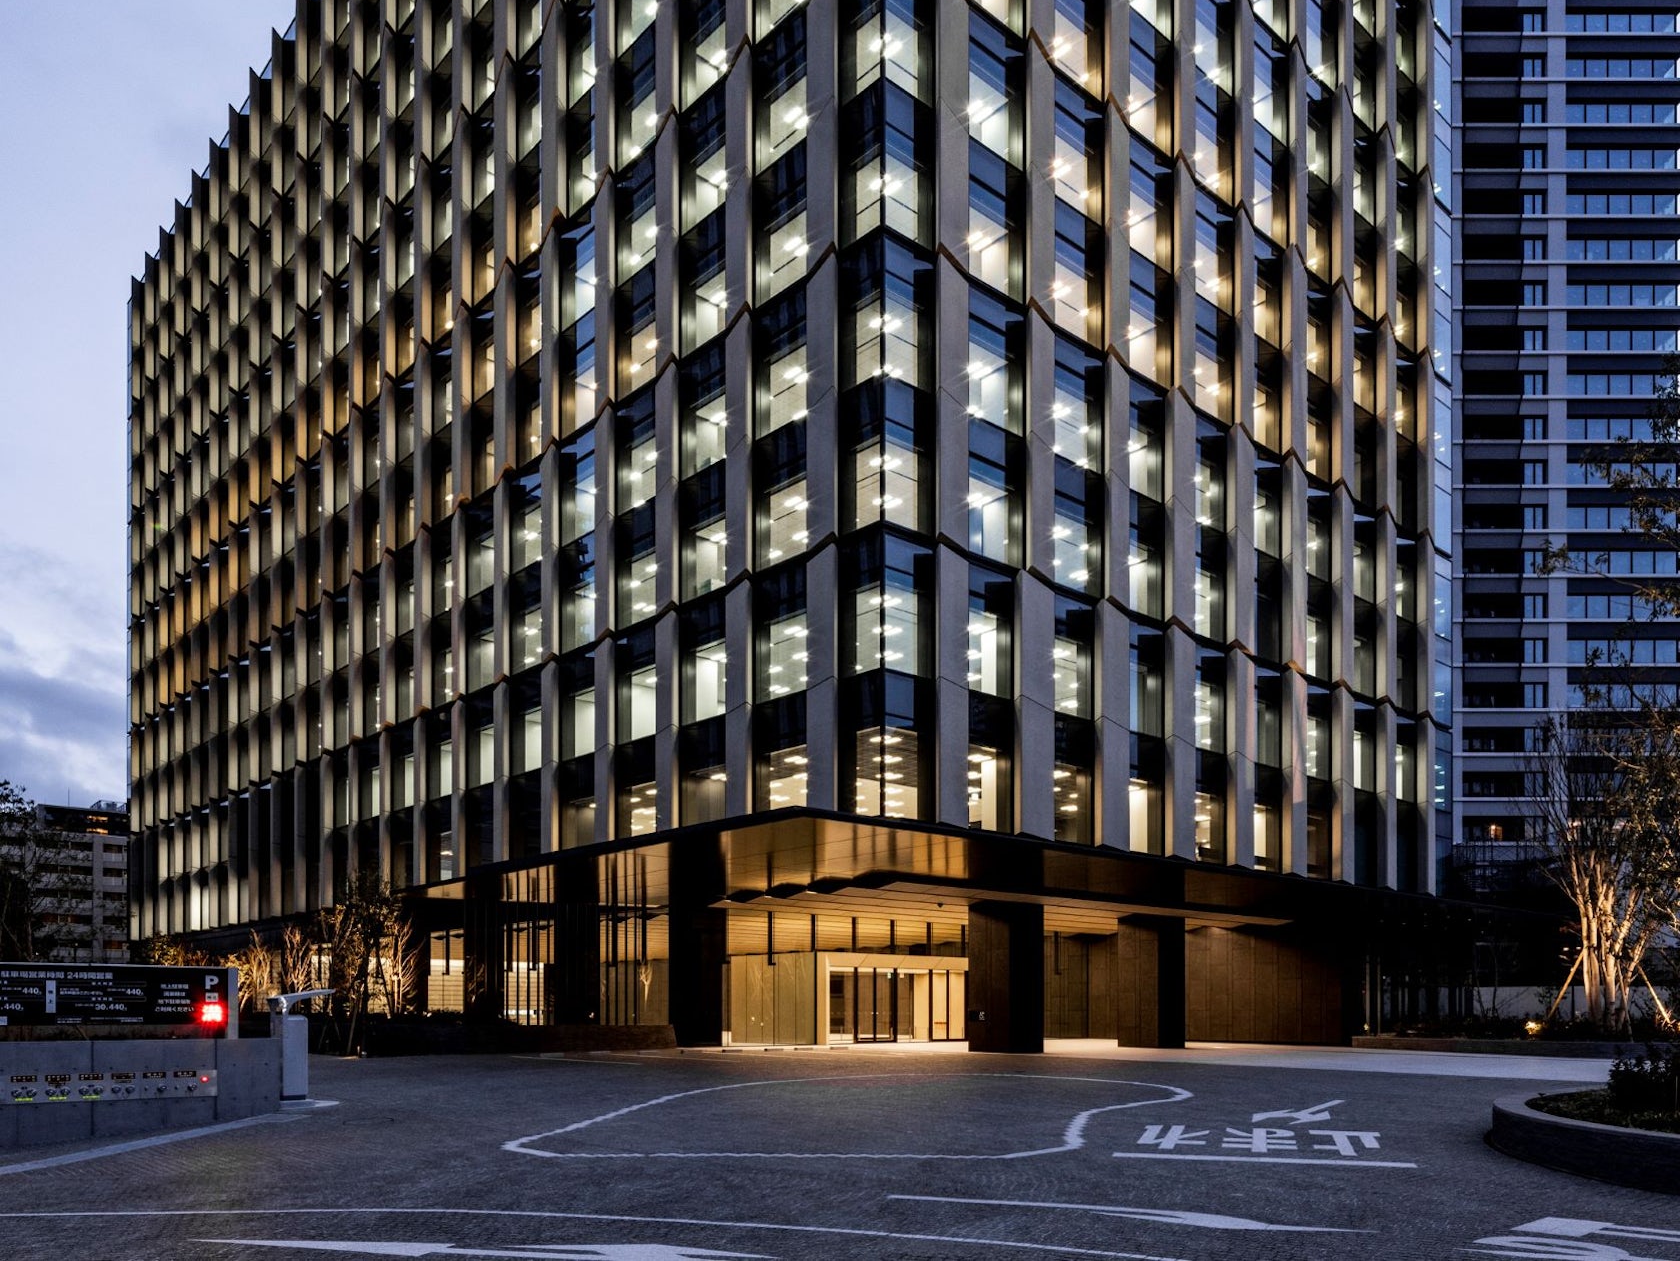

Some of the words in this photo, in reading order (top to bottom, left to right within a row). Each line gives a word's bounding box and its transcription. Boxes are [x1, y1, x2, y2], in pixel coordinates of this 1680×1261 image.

[204, 974, 219, 990] P
[1136, 1124, 1381, 1157] 止まれ
